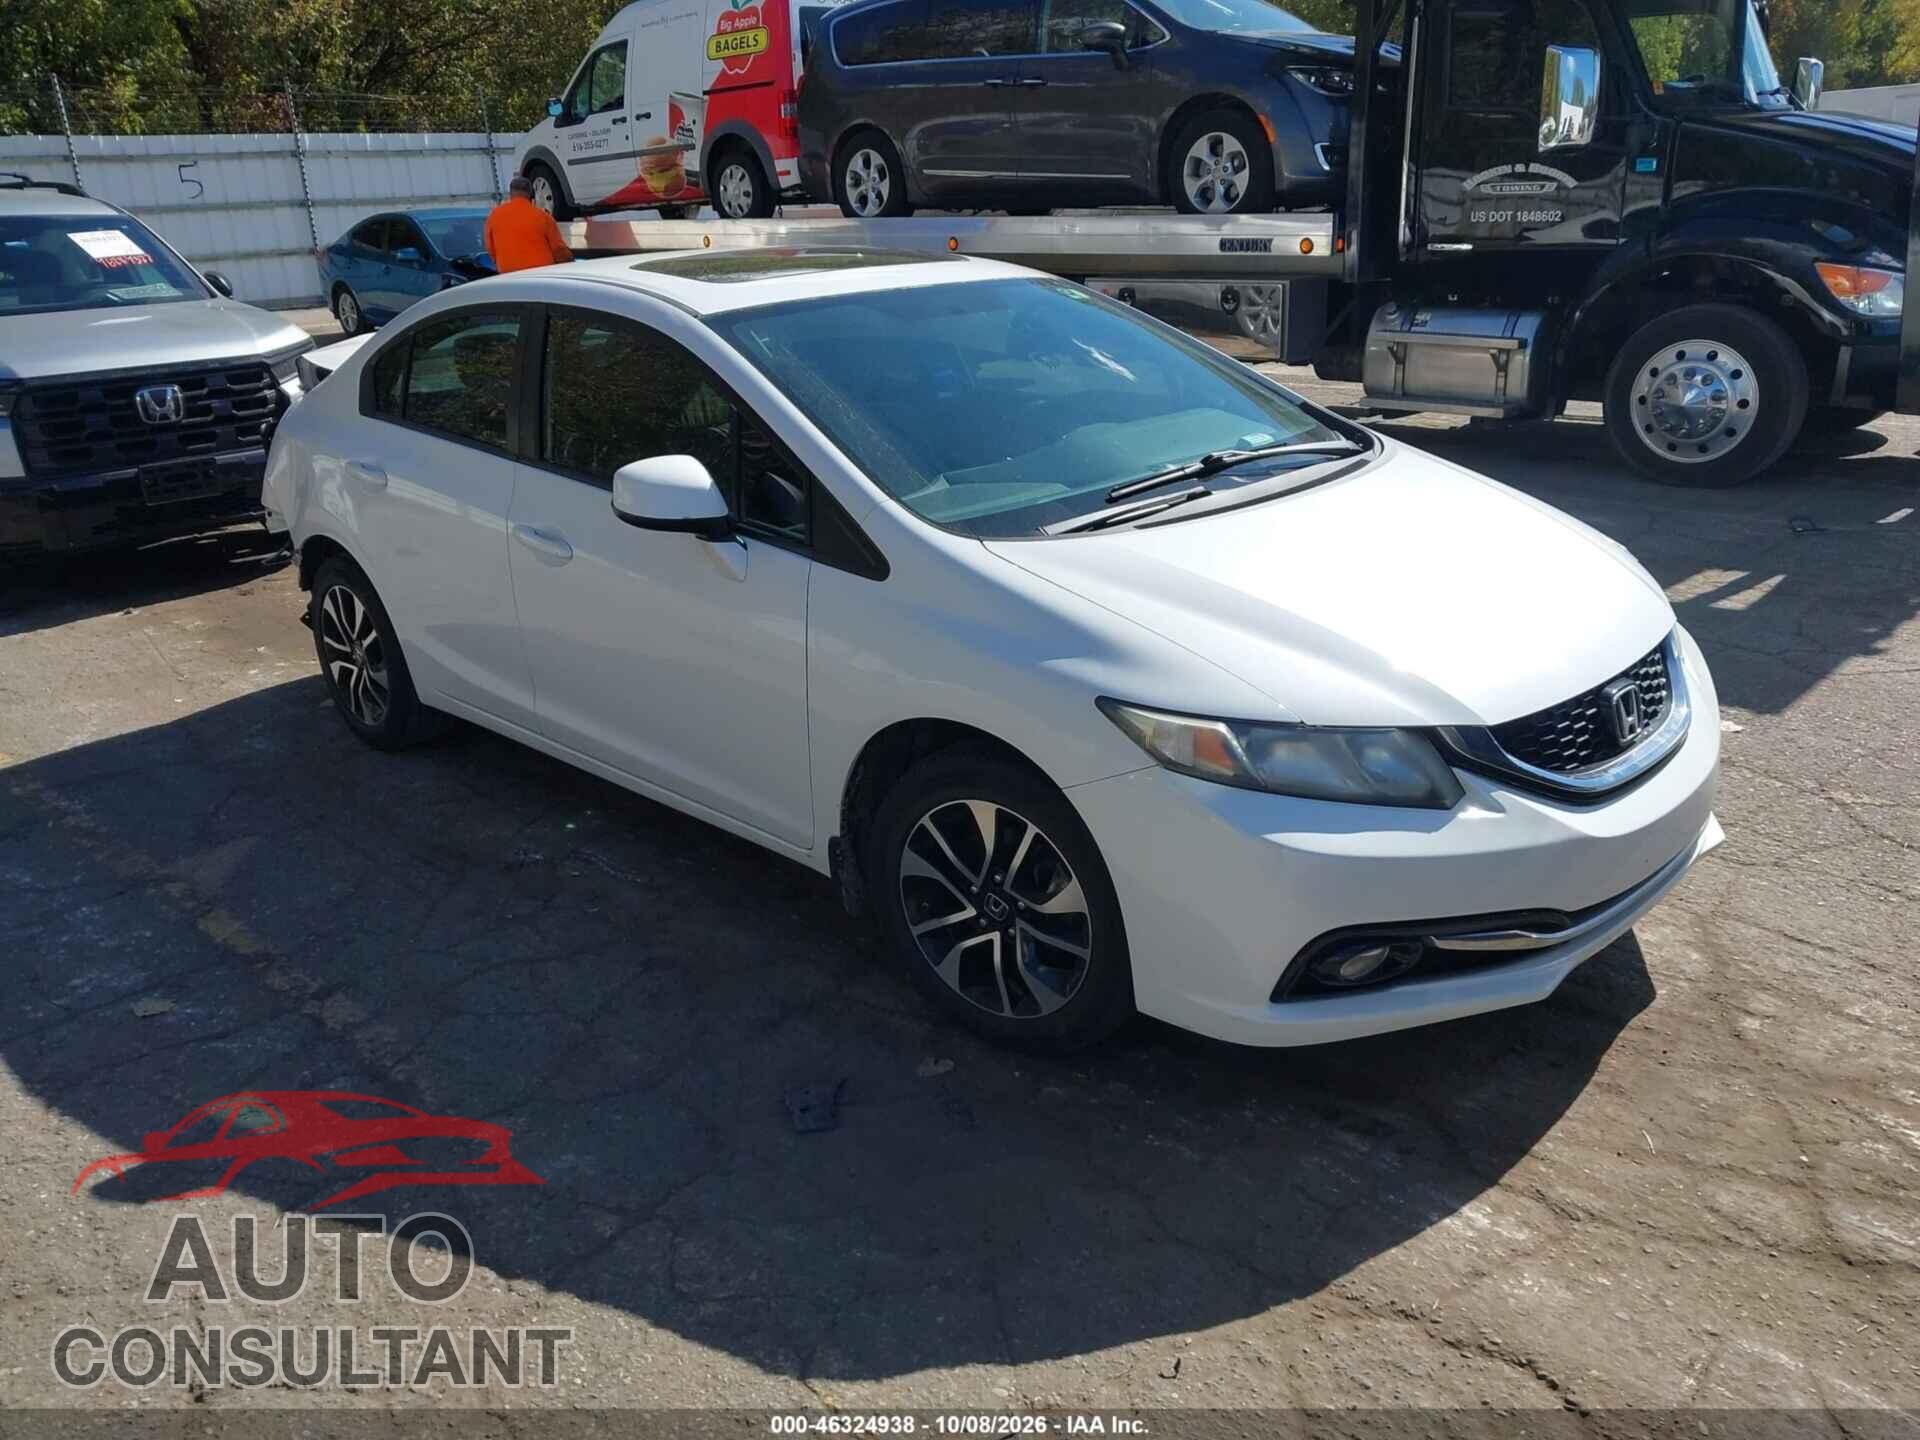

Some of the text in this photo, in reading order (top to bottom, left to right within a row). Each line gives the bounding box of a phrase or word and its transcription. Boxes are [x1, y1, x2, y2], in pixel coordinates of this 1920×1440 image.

[720, 15, 757, 31] Big Apple
[715, 33, 759, 53] BAGELS
[178, 160, 204, 199] 5
[1494, 184, 1541, 192] TOWING
[1471, 210, 1562, 222] US DOT 1848602
[1219, 237, 1274, 253] CENTURY
